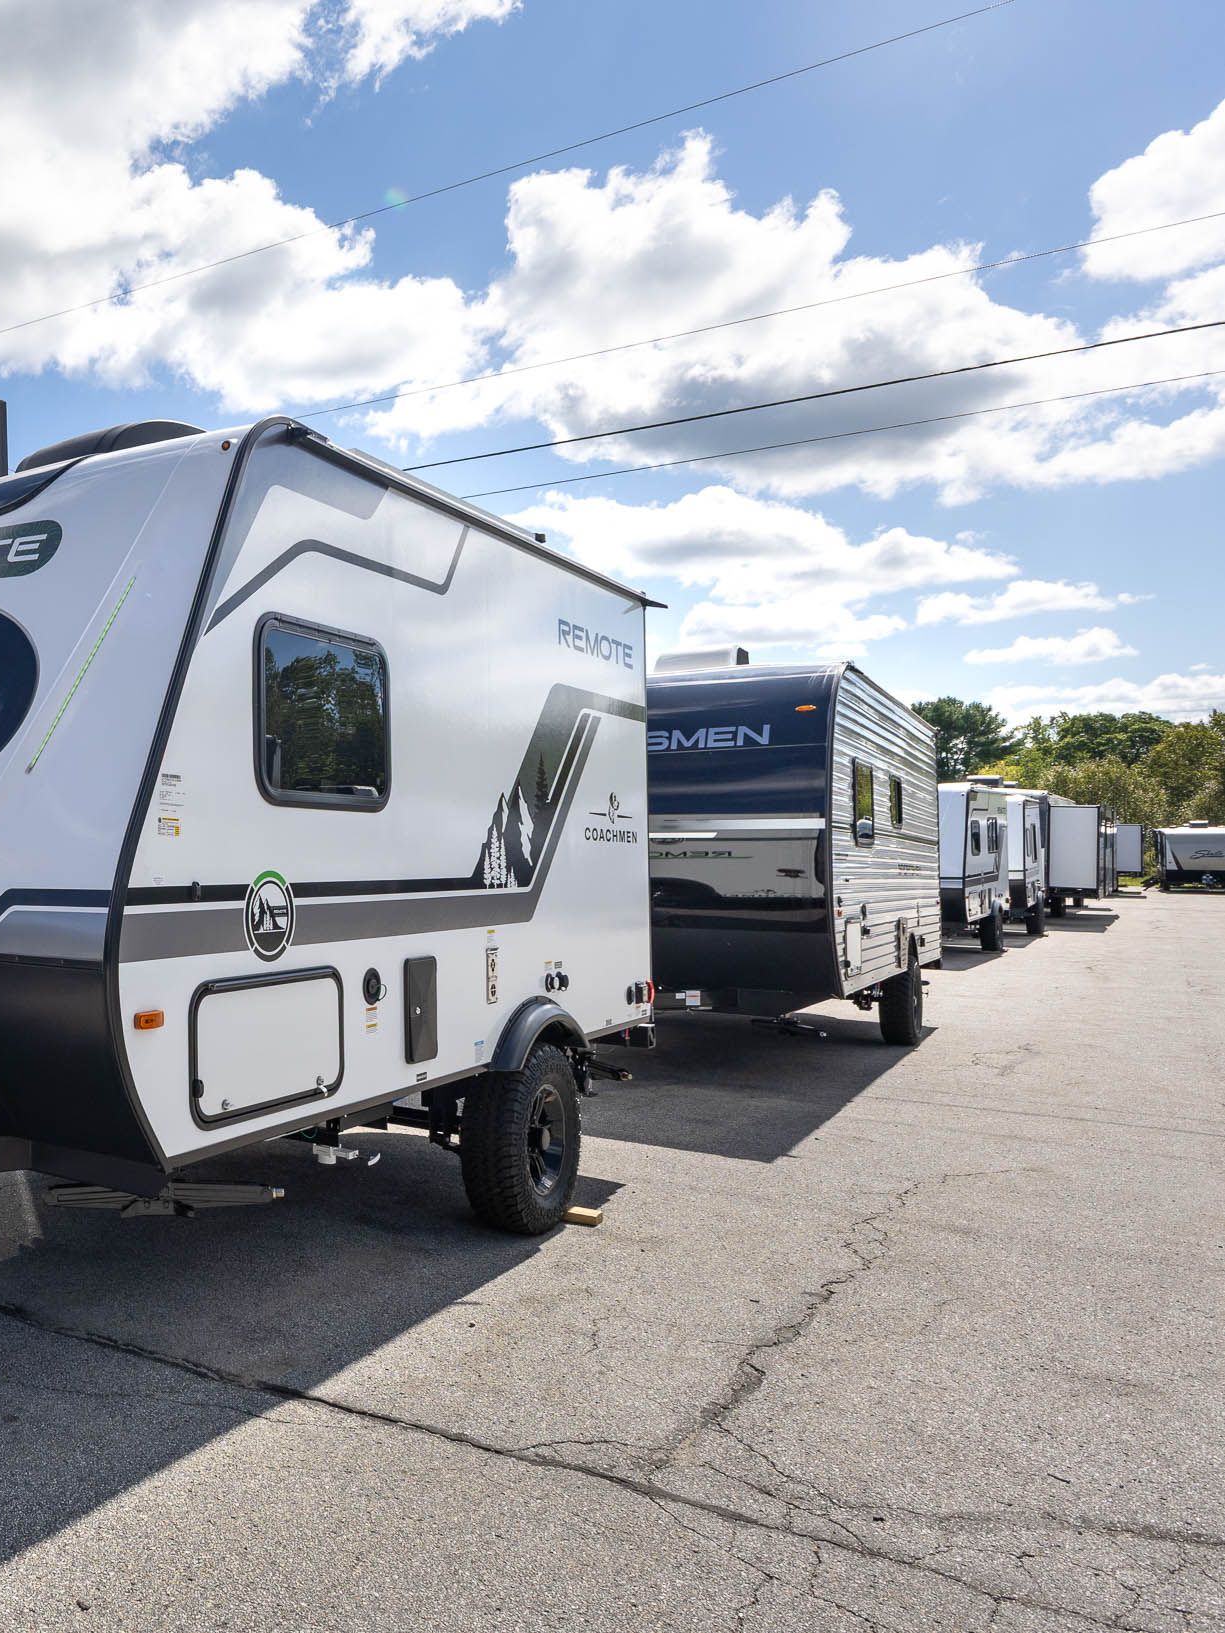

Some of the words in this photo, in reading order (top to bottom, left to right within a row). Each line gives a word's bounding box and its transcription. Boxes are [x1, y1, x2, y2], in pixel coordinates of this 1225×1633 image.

[558, 618, 633, 670] REMOTE
[647, 724, 771, 750] SMEN
[584, 827, 638, 844] COACHMEN
